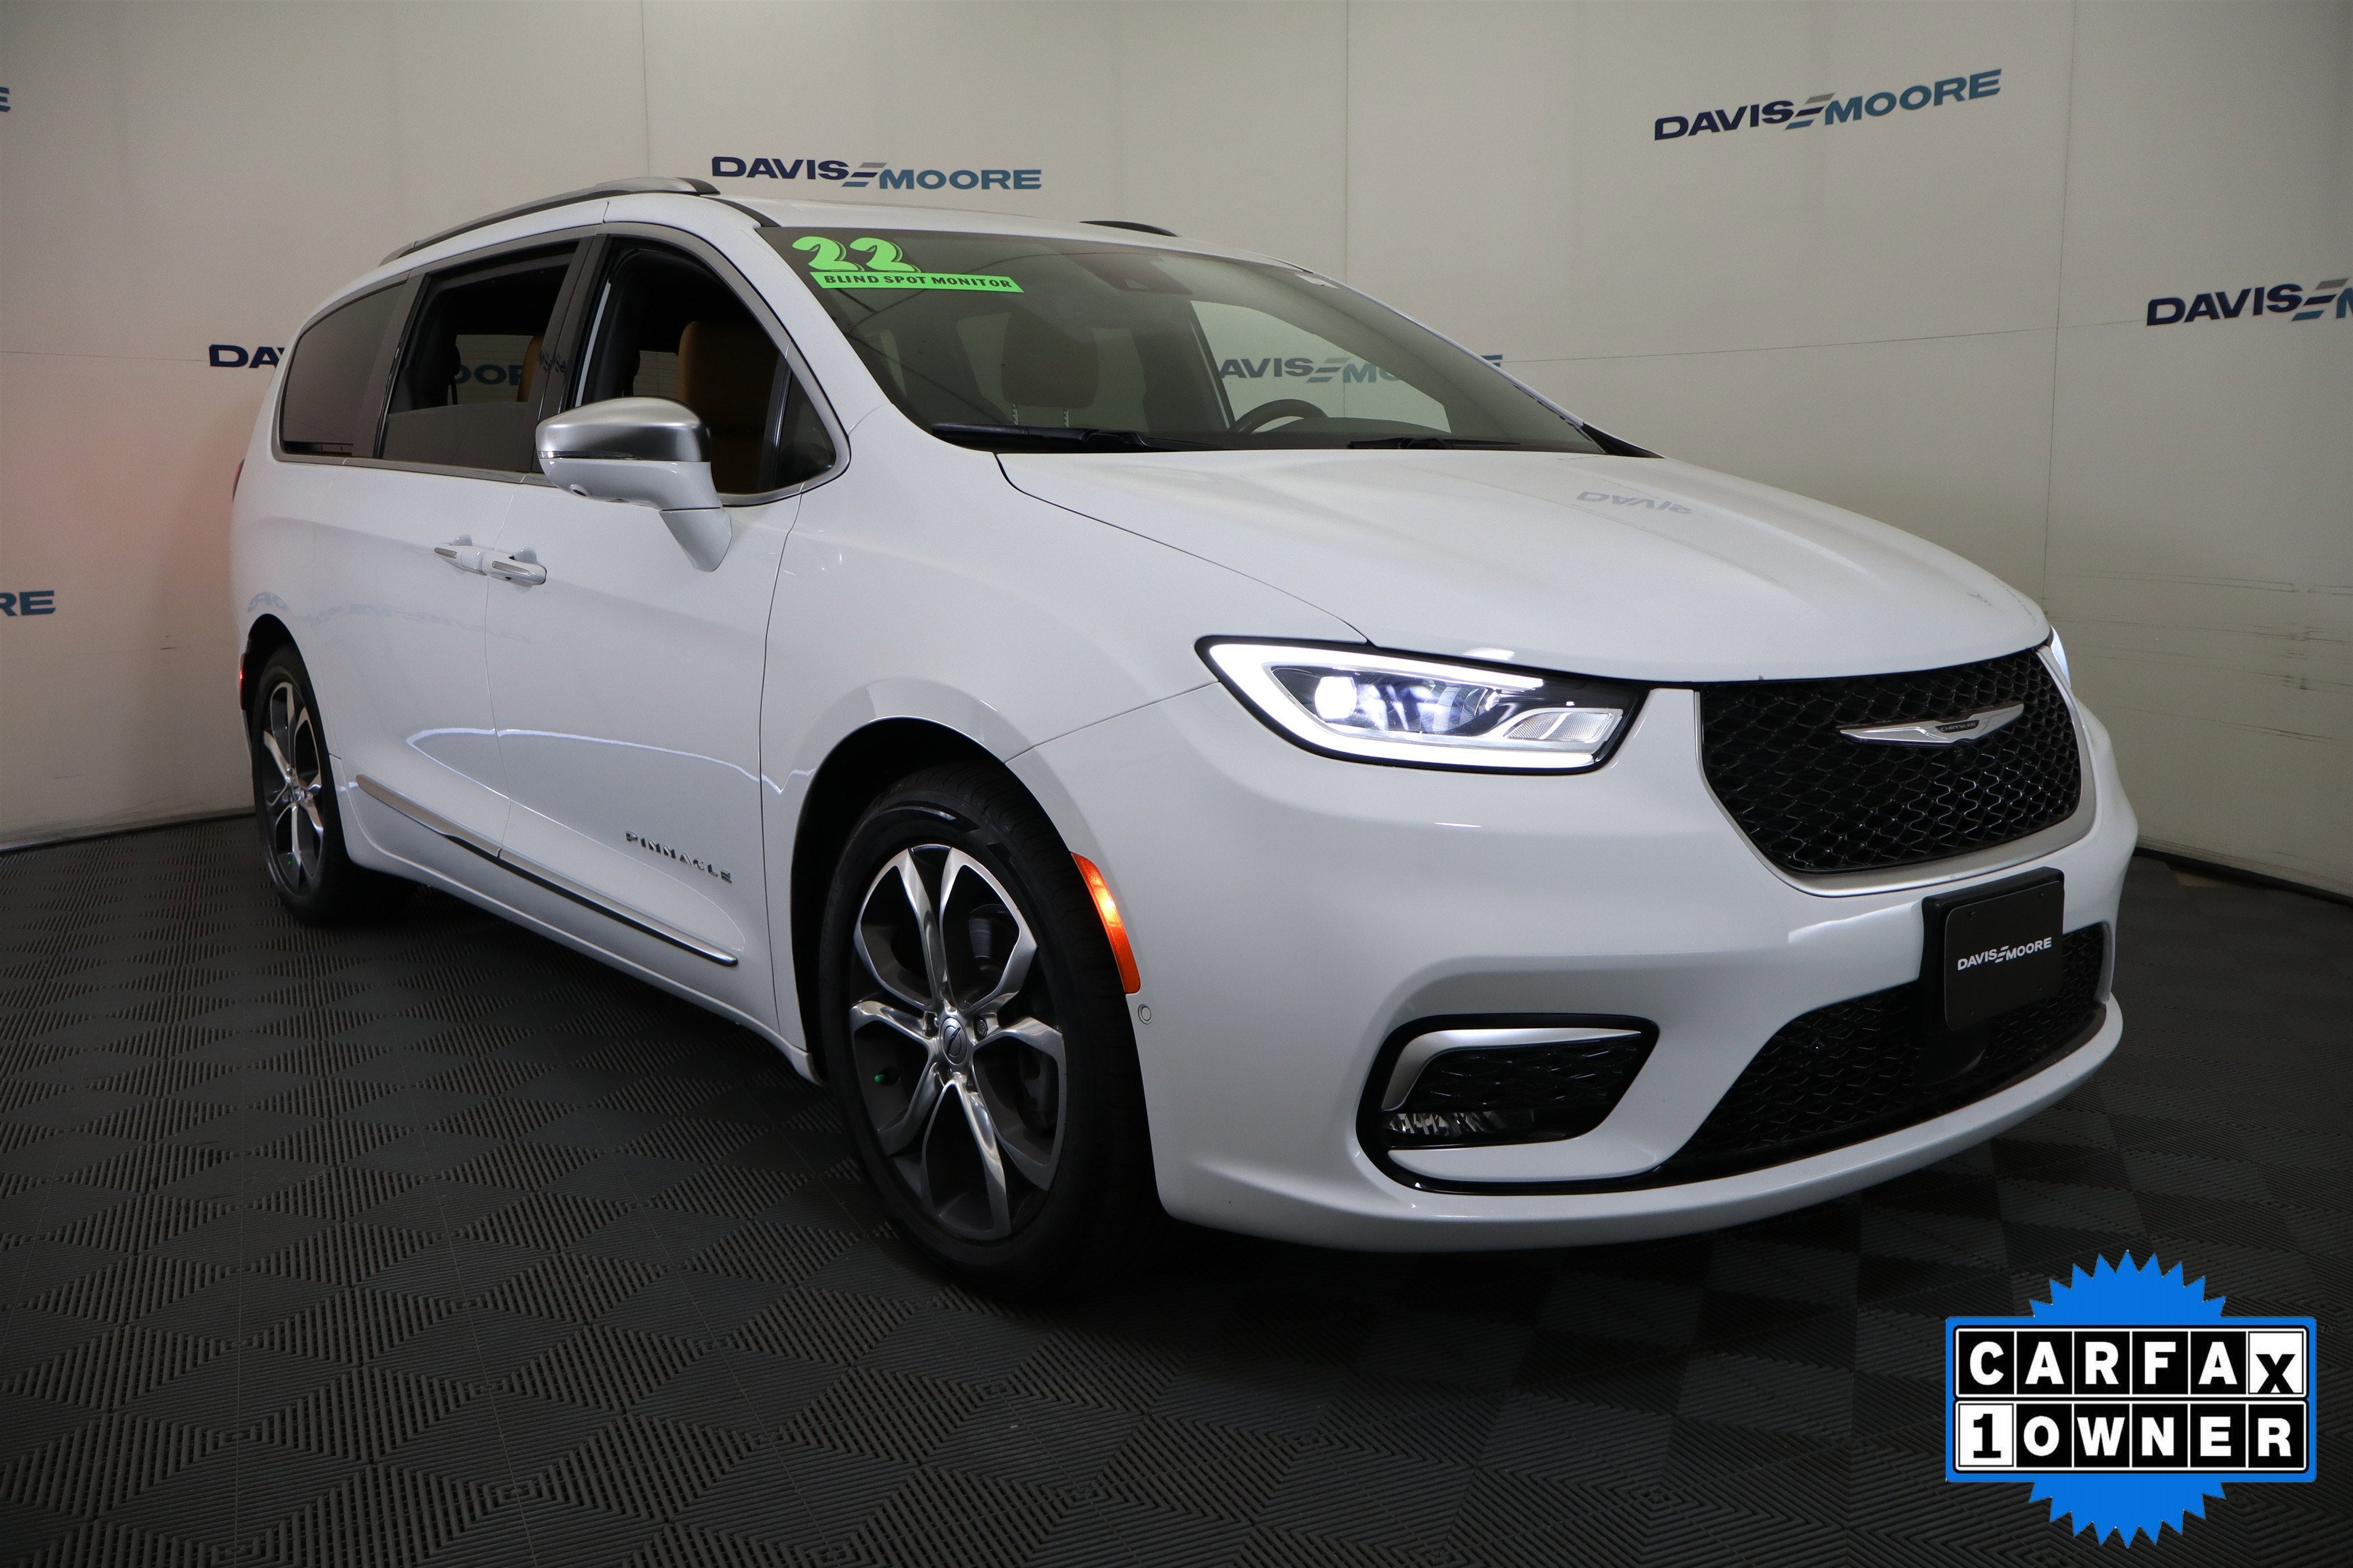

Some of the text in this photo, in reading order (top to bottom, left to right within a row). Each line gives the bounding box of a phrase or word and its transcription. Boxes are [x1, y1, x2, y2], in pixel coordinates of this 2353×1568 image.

[1654, 68, 2002, 141] DAVIS MOORE
[712, 156, 1042, 190] DAVIS MOORE
[792, 236, 920, 273] 22
[824, 275, 1013, 288] BLIND SPOT MONITOR
[2146, 283, 2303, 326] DAVIS
[1941, 722, 1976, 732] CHRYSLER
[625, 830, 732, 883] PINNACLE
[1957, 937, 2052, 971] DAVIS MOORE
